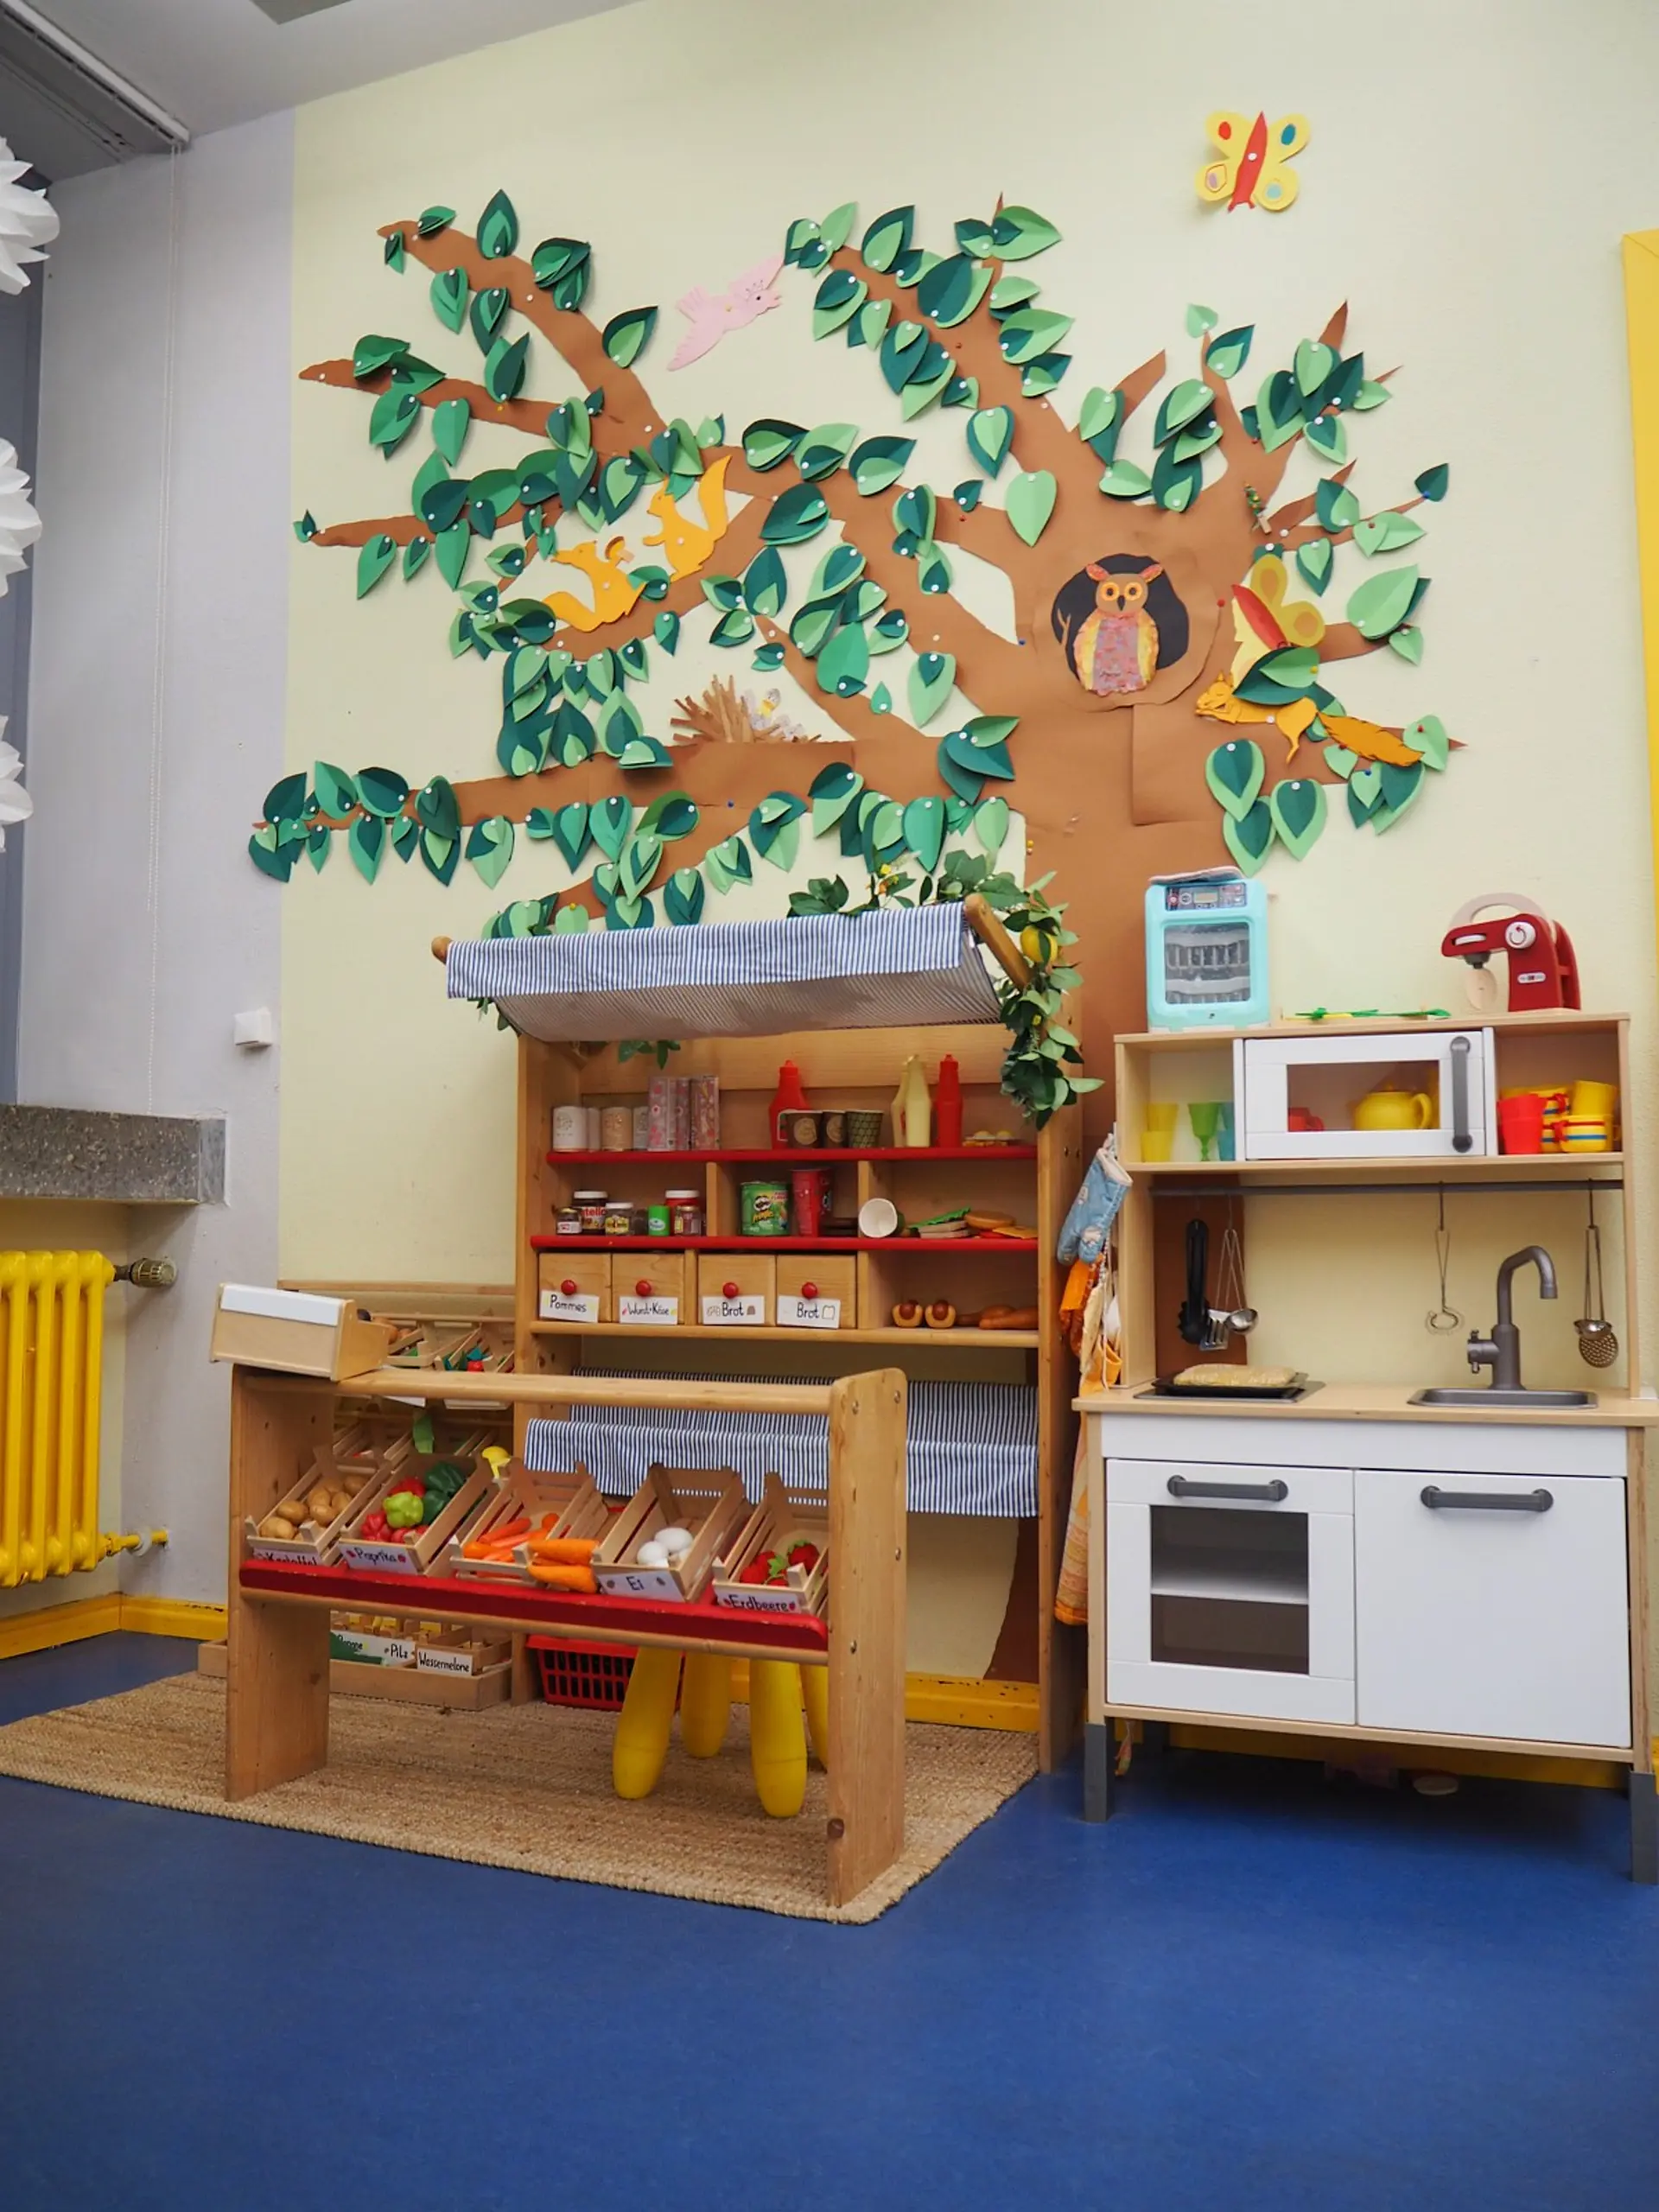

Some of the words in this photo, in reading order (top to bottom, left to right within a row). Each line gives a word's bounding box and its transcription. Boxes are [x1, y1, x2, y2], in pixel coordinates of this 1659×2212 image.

[550, 1294, 587, 1313] Pommes
[721, 1301, 744, 1317] Brot
[796, 1301, 820, 1319] Brot
[353, 1547, 397, 1566] Paprika
[626, 1576, 645, 1591] Ei
[728, 1594, 788, 1612] Erdbeere
[391, 1643, 409, 1659] Pilz
